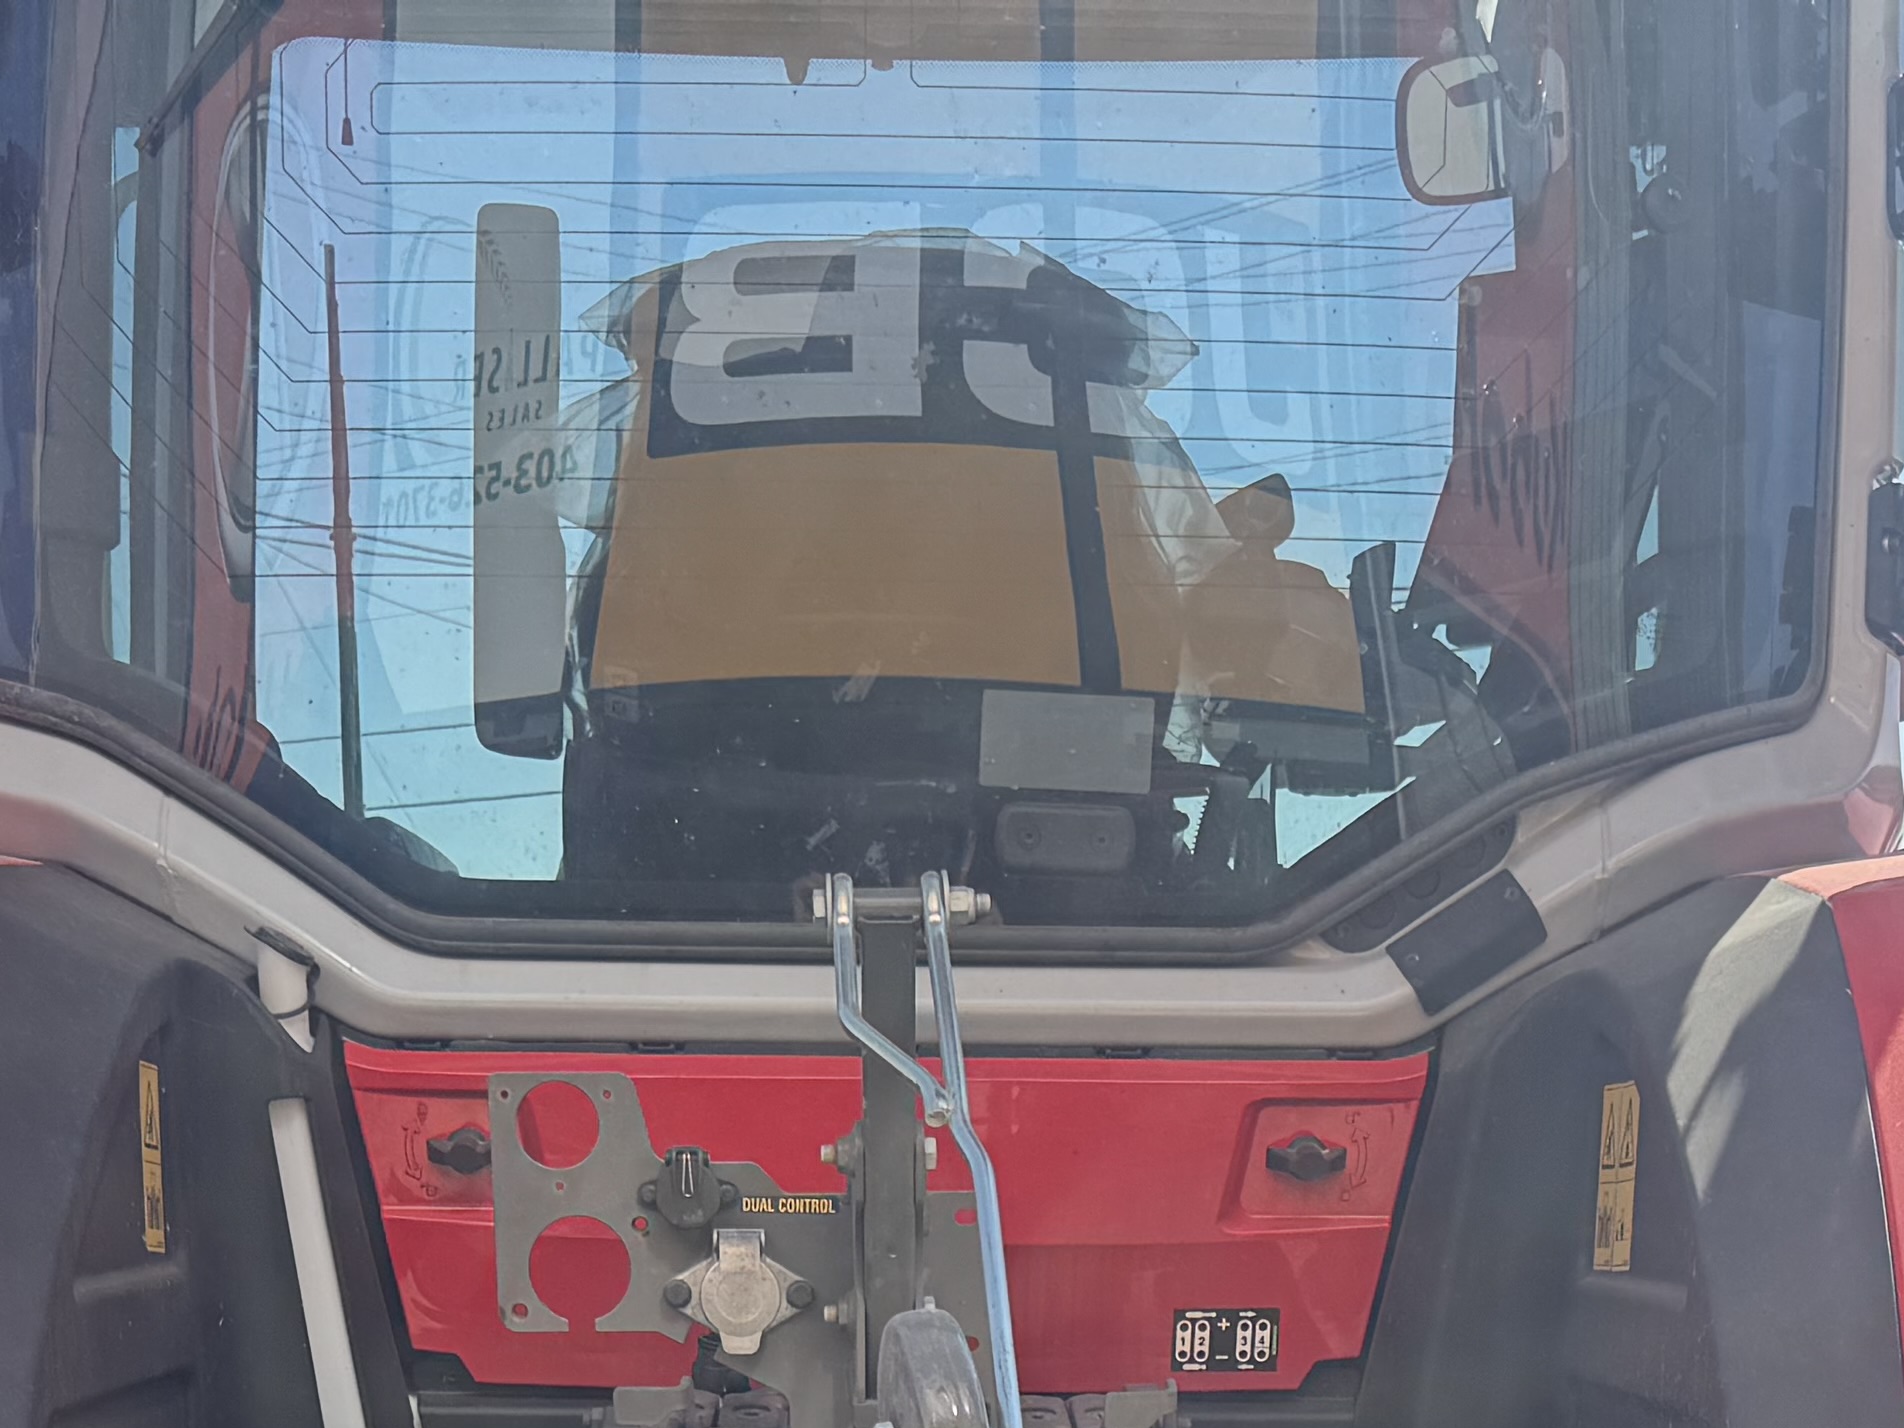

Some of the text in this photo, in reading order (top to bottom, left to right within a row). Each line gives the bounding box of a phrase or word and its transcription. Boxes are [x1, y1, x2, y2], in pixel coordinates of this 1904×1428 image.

[742, 1197, 836, 1214] DUAL CONTROL
[1198, 1336, 1206, 1346] 2
[1241, 1336, 1248, 1346] 3
[1258, 1336, 1266, 1345] 4
